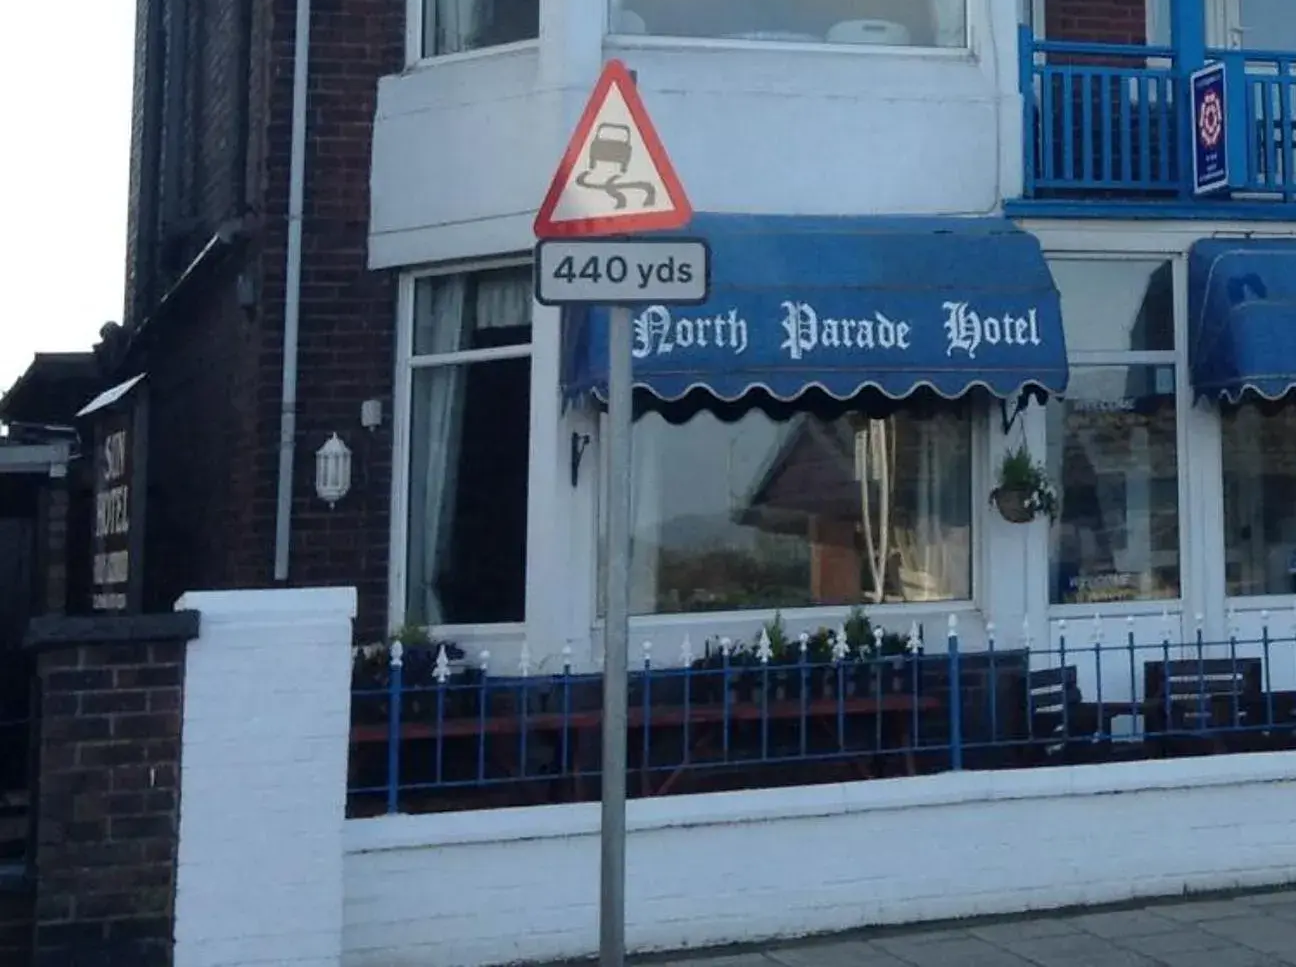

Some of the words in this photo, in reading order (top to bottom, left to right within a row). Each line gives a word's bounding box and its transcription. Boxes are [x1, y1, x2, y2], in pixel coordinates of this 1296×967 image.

[553, 255, 628, 284] 440
[636, 255, 693, 289] yds
[631, 304, 748, 359] North
[780, 300, 913, 360] Parade
[941, 300, 1041, 360] Hotel
